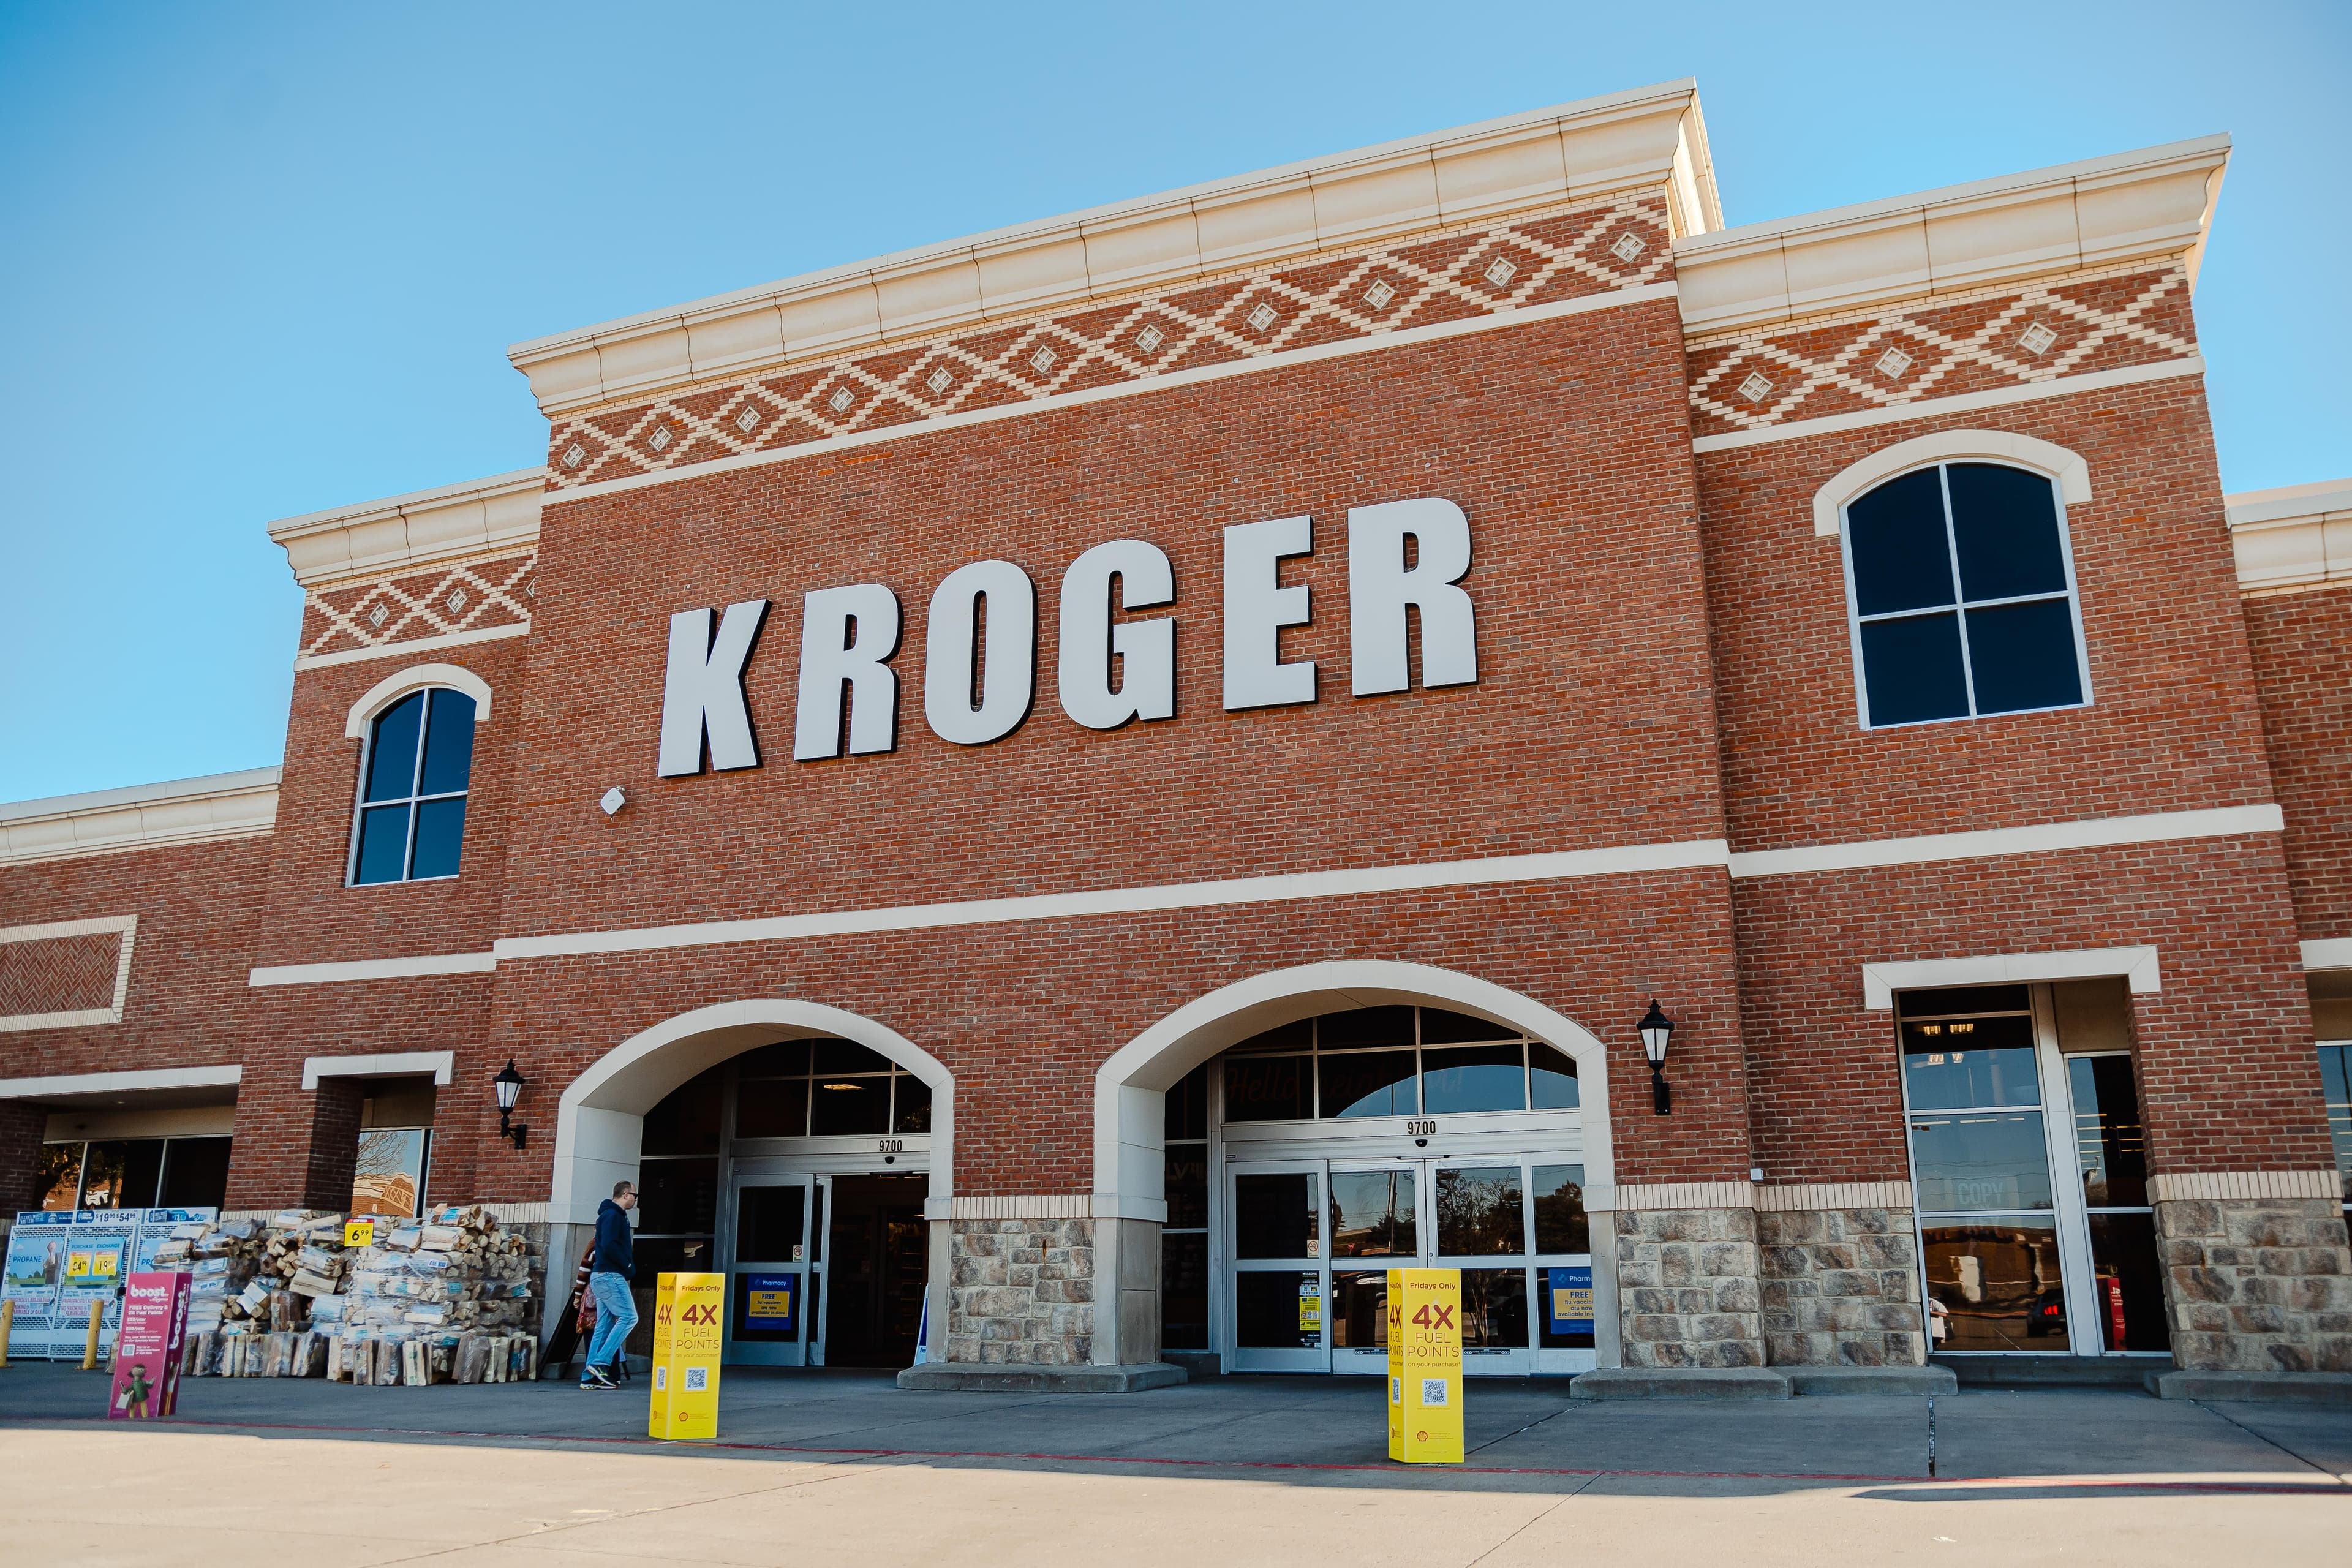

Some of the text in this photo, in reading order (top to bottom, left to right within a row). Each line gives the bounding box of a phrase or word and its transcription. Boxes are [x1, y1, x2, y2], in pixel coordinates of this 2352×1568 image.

[658, 497, 1479, 778] KROGER
[1408, 1121, 1436, 1134] 9700
[879, 1140, 902, 1152] 9700
[1958, 1182, 2003, 1205] COPY
[130, 1284, 169, 1297] boost
[1409, 1282, 1436, 1291] Fridays
[168, 1283, 186, 1349] boost
[658, 1303, 673, 1325] 4X
[681, 1304, 717, 1325] 4X
[1389, 1303, 1401, 1329] 4X
[1412, 1304, 1454, 1330] 4X
[684, 1328, 714, 1338] FUEL
[1390, 1331, 1401, 1343] FUEL
[1416, 1332, 1452, 1343] FUEL
[676, 1340, 720, 1350] POINTS
[1389, 1344, 1403, 1357] POINTS
[1408, 1346, 1460, 1357] POINTS
